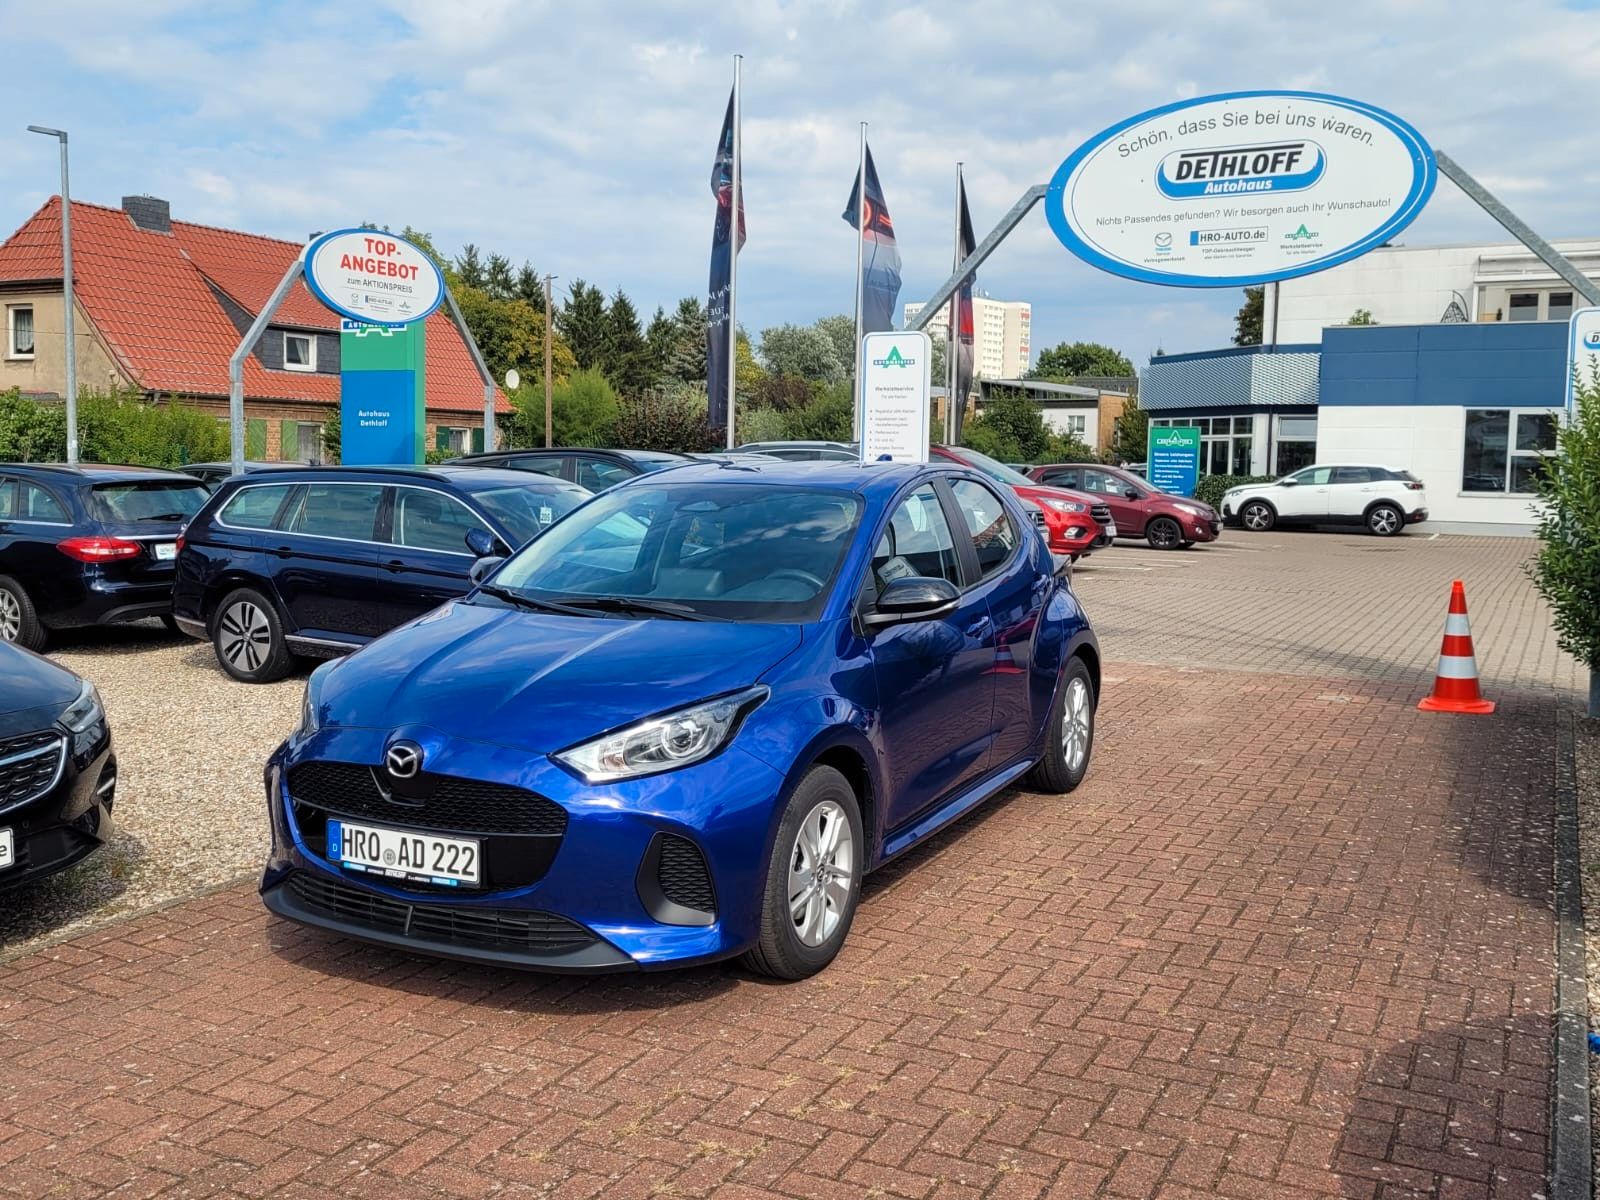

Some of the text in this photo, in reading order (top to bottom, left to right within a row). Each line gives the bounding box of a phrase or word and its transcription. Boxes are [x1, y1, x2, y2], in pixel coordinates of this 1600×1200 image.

[1118, 110, 1374, 157] Schön, dass Sie bei uns waren.
[1175, 144, 1305, 181] DETHLOFF
[1204, 180, 1273, 194] Autohaus
[1096, 197, 1392, 226] Nichts Passendes gefunden? Wir besorgen auch Ihr Wunschauto!
[1200, 230, 1266, 243] HRO-AUTO.de
[364, 238, 402, 257] TOP-
[340, 254, 419, 281] ANGEBOT
[347, 278, 413, 294] zum AKTIONSPREIS
[358, 409, 390, 417] Autohaus
[332, 843, 338, 852] D
[341, 827, 380, 862] HRO
[398, 836, 425, 870] AD
[432, 842, 475, 877] 222
